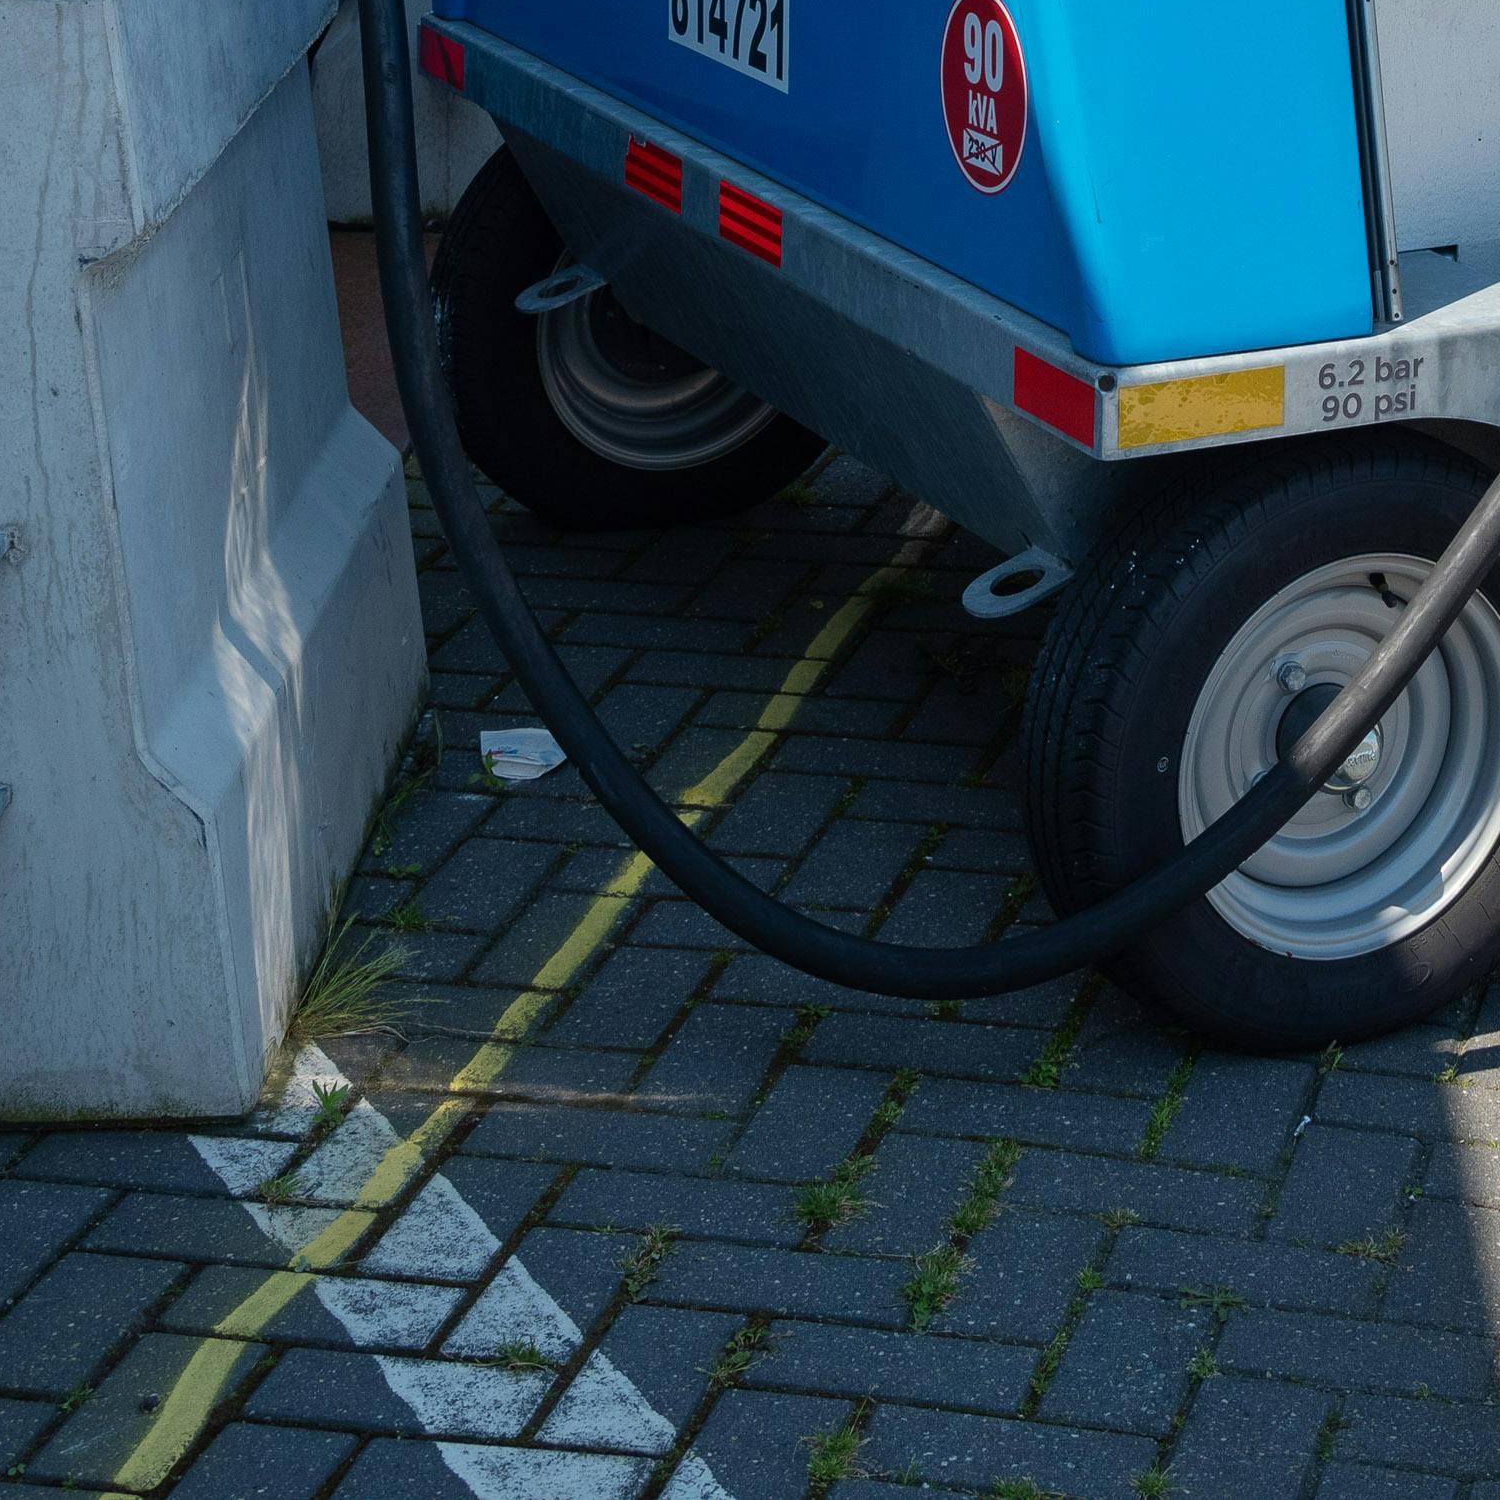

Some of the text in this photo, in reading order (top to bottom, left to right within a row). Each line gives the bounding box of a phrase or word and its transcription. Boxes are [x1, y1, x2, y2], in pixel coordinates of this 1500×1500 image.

[963, 12, 1004, 93] 90
[968, 89, 998, 135] kVA
[967, 137, 986, 163] 230
[1317, 355, 1425, 390] 6.2 bar
[1321, 384, 1416, 423] 90 psi
